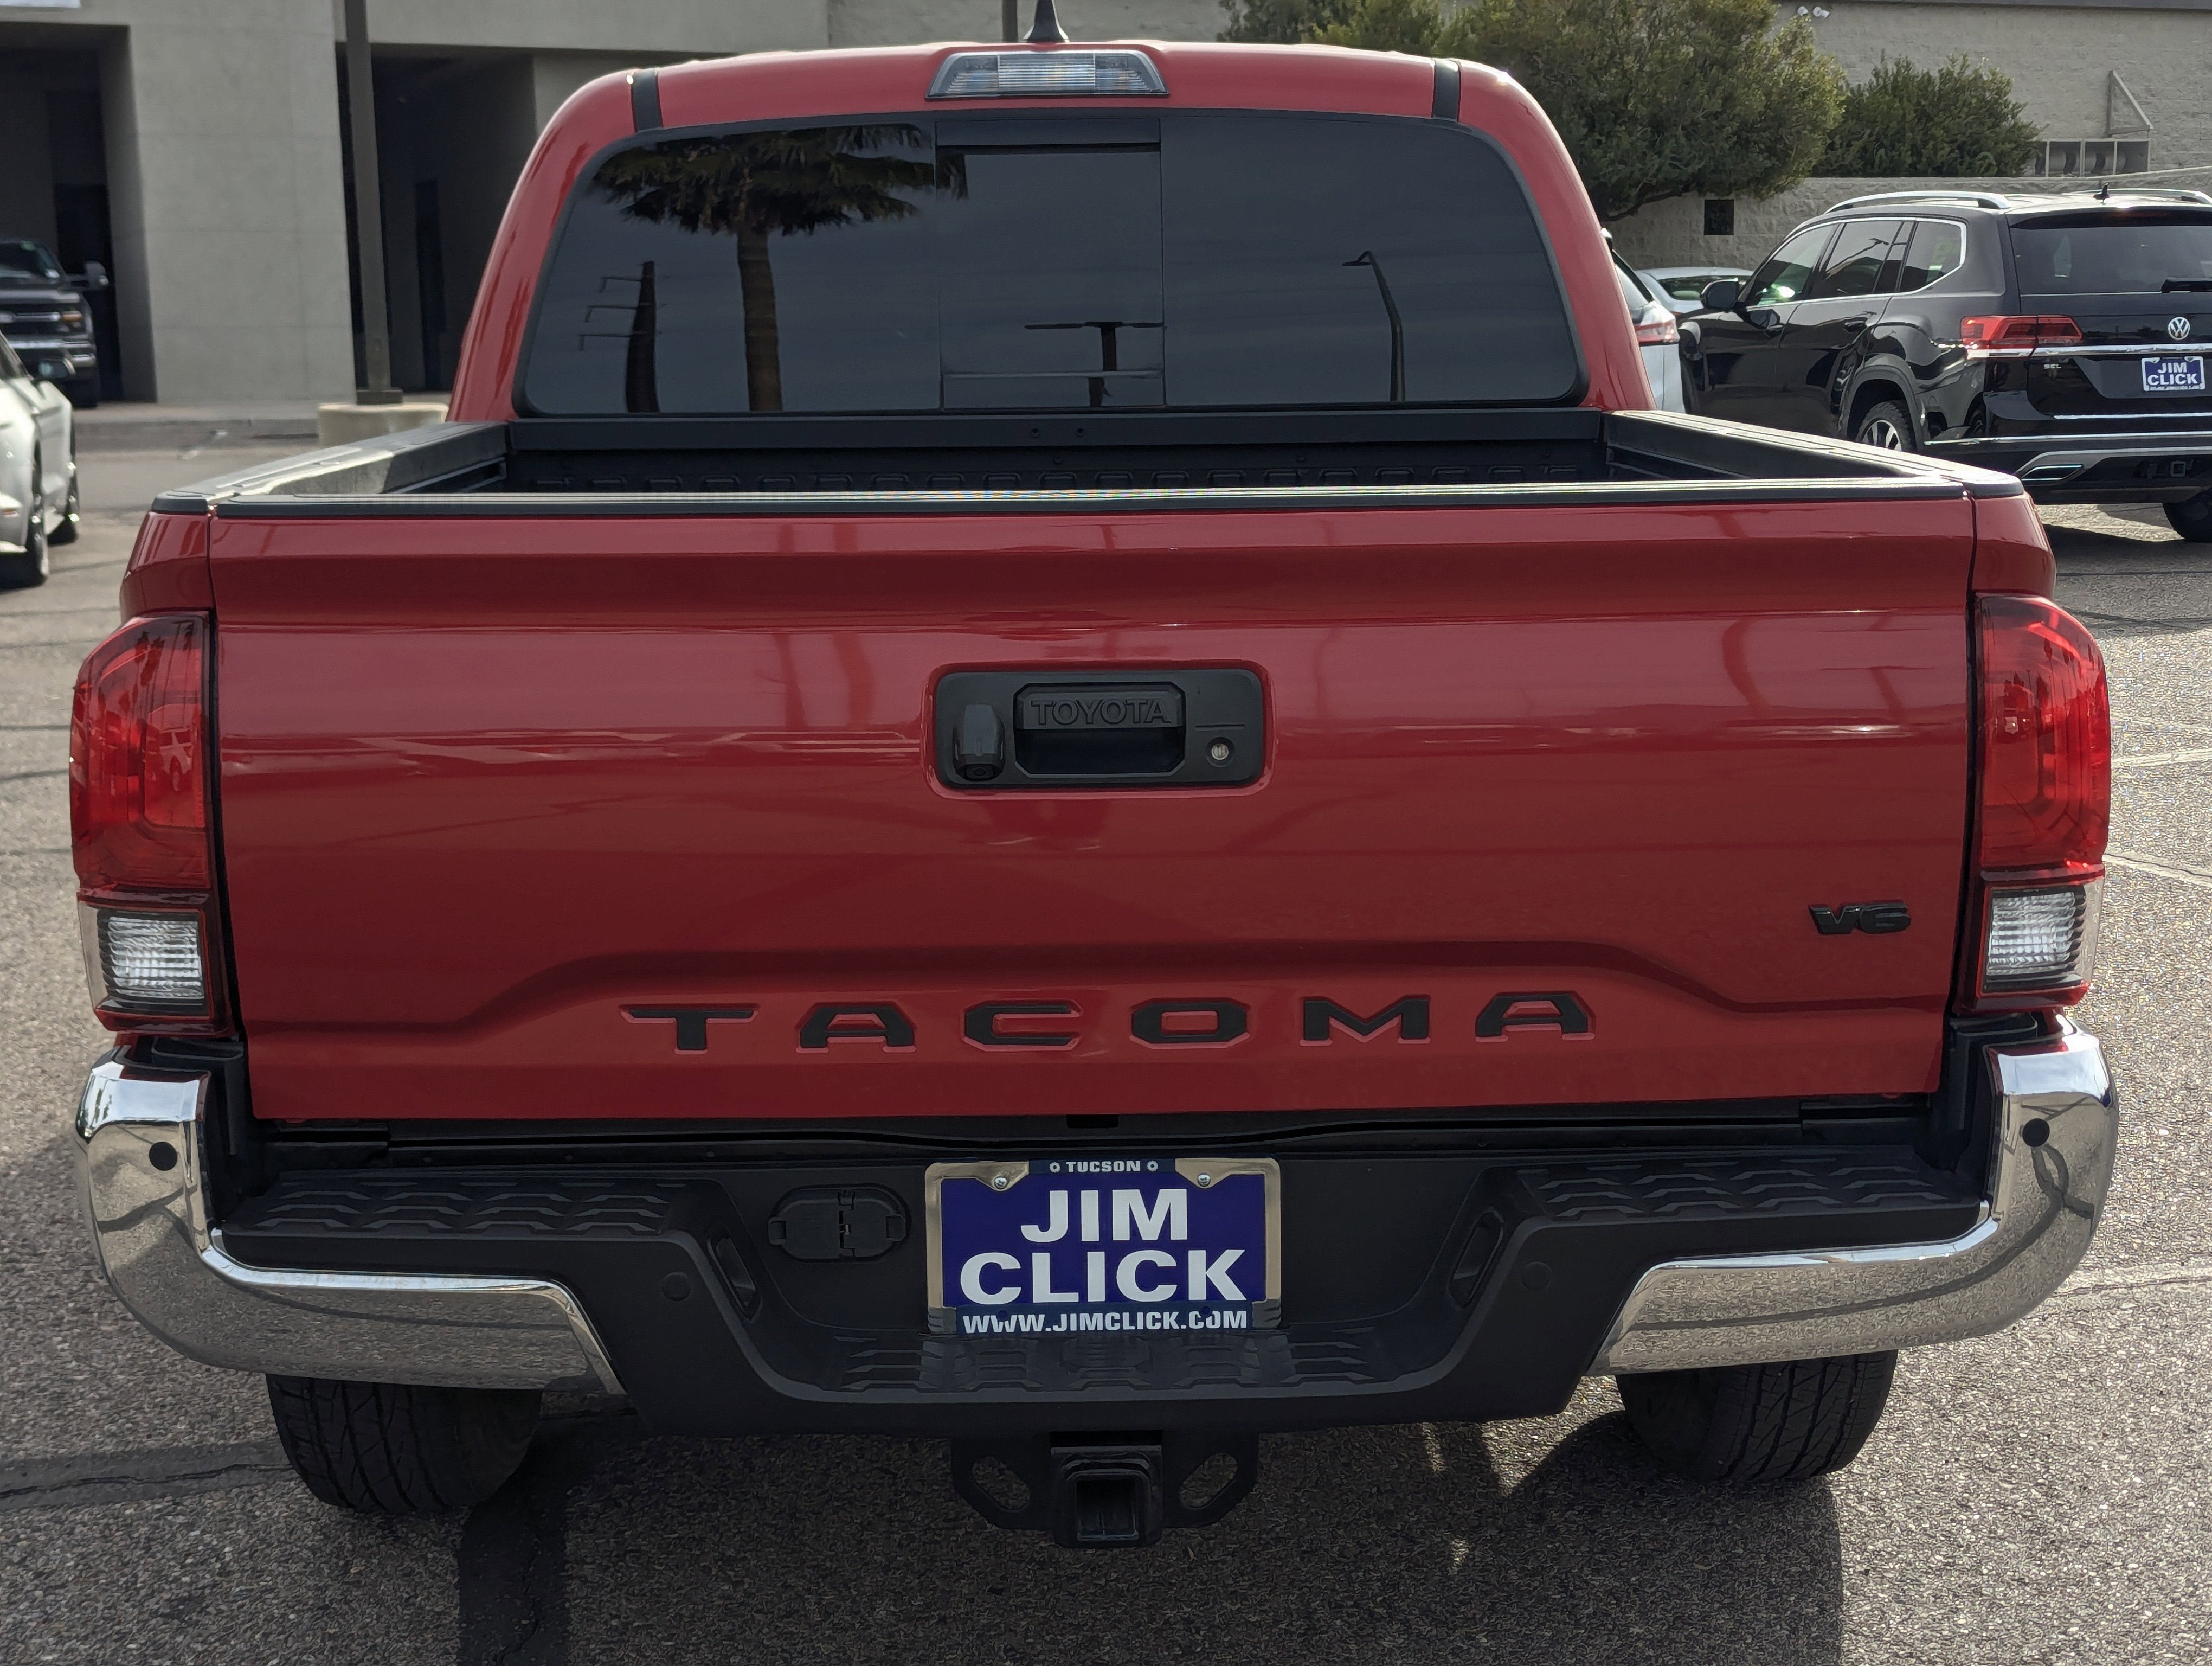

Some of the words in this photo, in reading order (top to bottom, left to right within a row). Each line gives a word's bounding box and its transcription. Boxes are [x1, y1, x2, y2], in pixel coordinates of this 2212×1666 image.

[2147, 374, 2198, 386] CLICK
[2157, 362, 2187, 373] JIM
[1030, 697, 1172, 726] TOYOTA
[1808, 900, 1912, 935] V6
[618, 991, 1595, 1055] TACOMA
[1065, 1161, 1141, 1173] TUCSON
[1020, 1188, 1188, 1243] JIM
[960, 1249, 1247, 1305] CLICK
[962, 1310, 1248, 1334] WWW.JIMCLICK.COM
